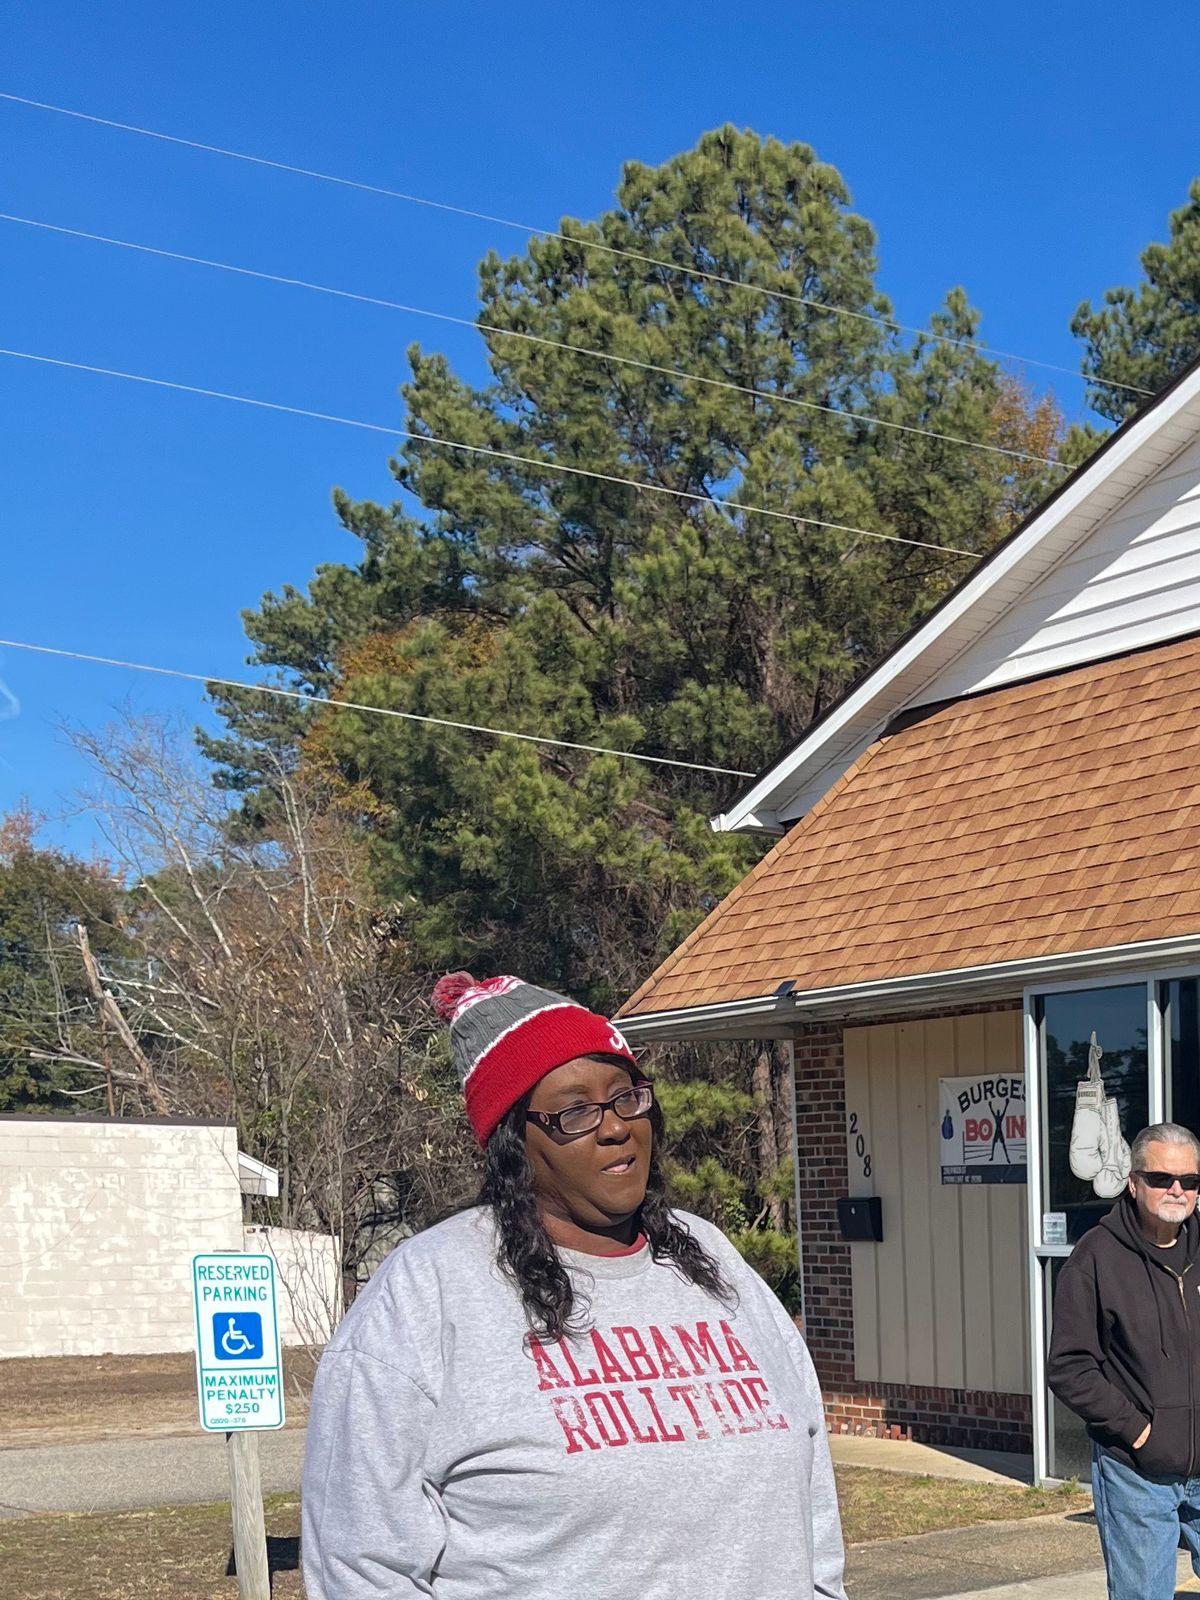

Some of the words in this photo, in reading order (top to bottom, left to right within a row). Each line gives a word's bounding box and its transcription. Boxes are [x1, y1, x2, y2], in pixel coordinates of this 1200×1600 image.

[964, 1115, 1027, 1142] BOXIN
[849, 1112, 871, 1178] 208
[198, 1265, 269, 1281] RESERVED
[203, 1286, 267, 1301] PARKING
[528, 1320, 759, 1391] ALABAMA
[205, 1374, 276, 1387] MAXIMUM
[207, 1388, 276, 1401] PENALTY
[225, 1402, 260, 1415] $250
